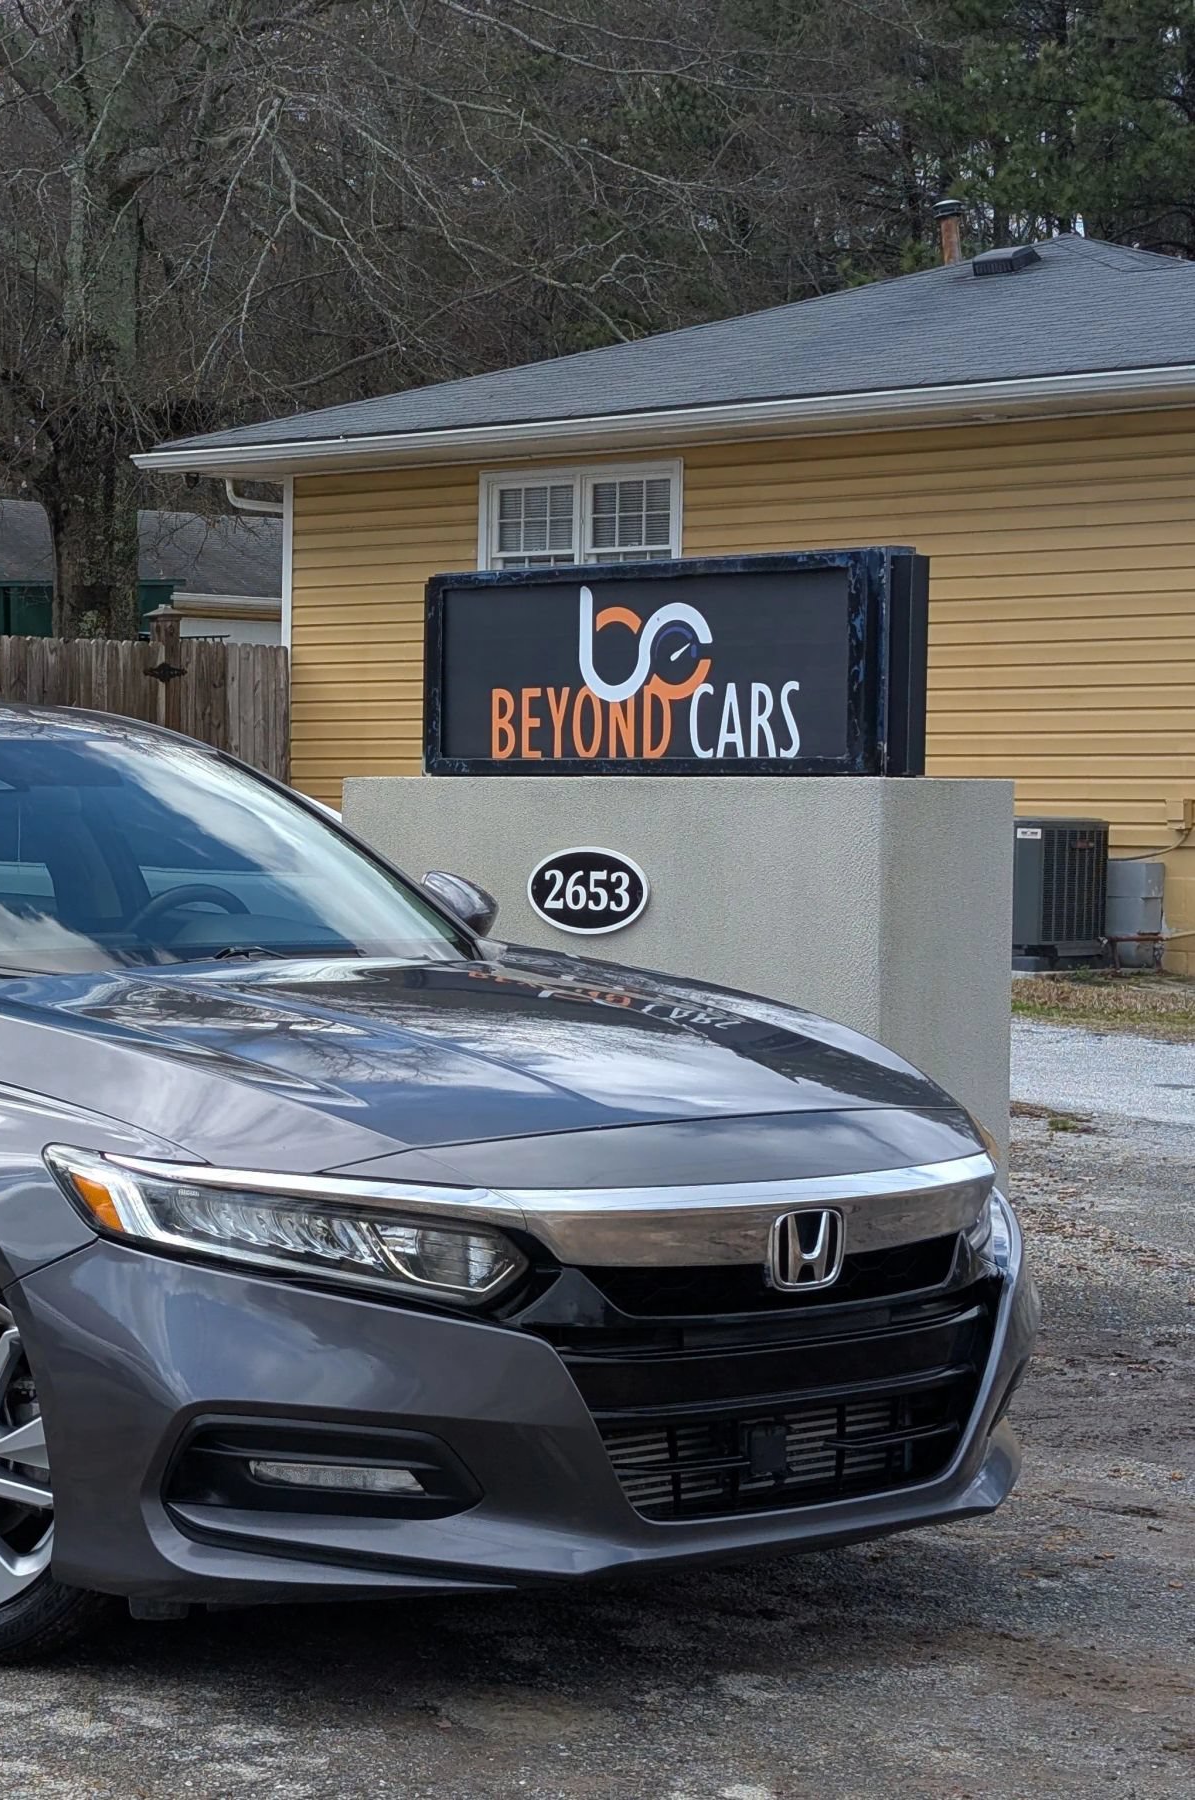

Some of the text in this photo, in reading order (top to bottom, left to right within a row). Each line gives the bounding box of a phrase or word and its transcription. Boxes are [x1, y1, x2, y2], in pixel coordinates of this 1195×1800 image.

[491, 681, 800, 759] BEYOND CARS
[544, 870, 630, 911] 2653
